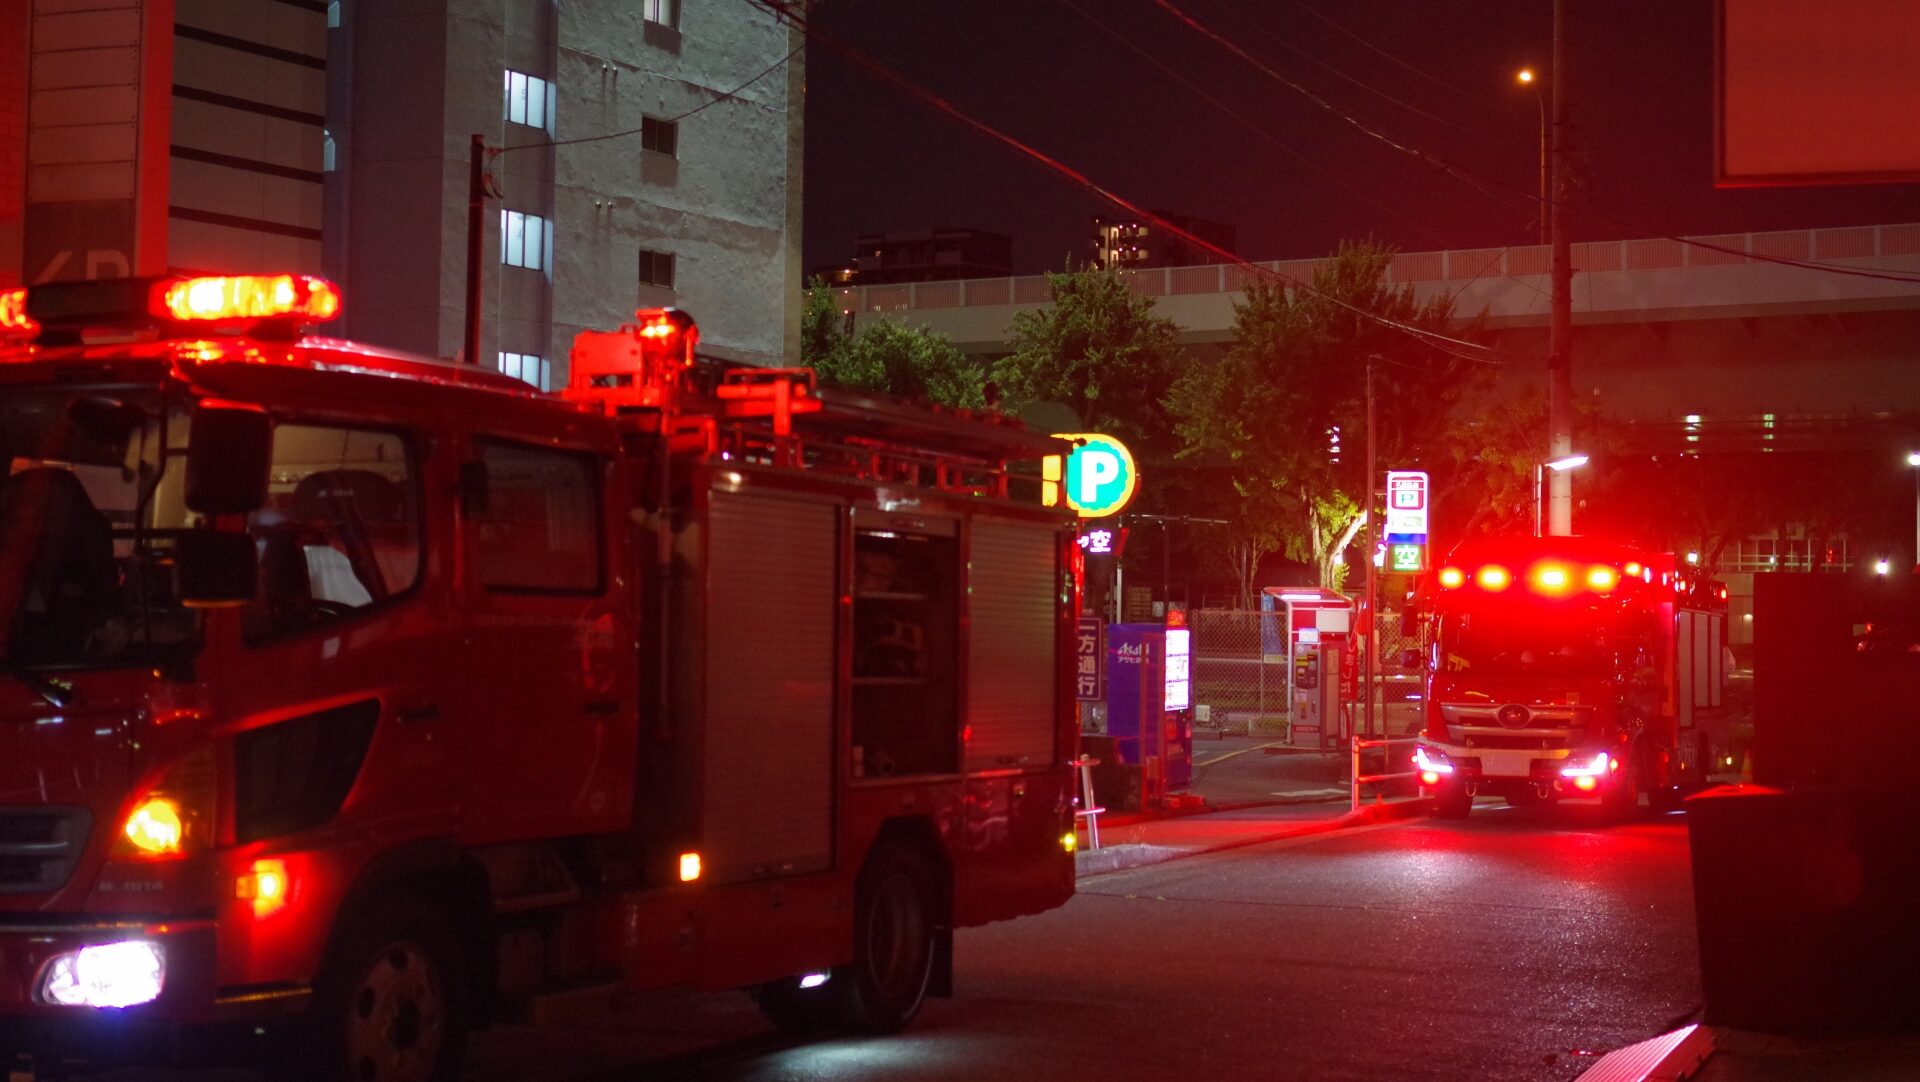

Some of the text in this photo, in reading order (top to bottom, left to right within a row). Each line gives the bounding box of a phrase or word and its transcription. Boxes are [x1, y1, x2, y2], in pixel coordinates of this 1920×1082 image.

[1081, 451, 1119, 502] P
[1401, 493, 1414, 504] P
[1078, 625, 1096, 695] 一方通行
